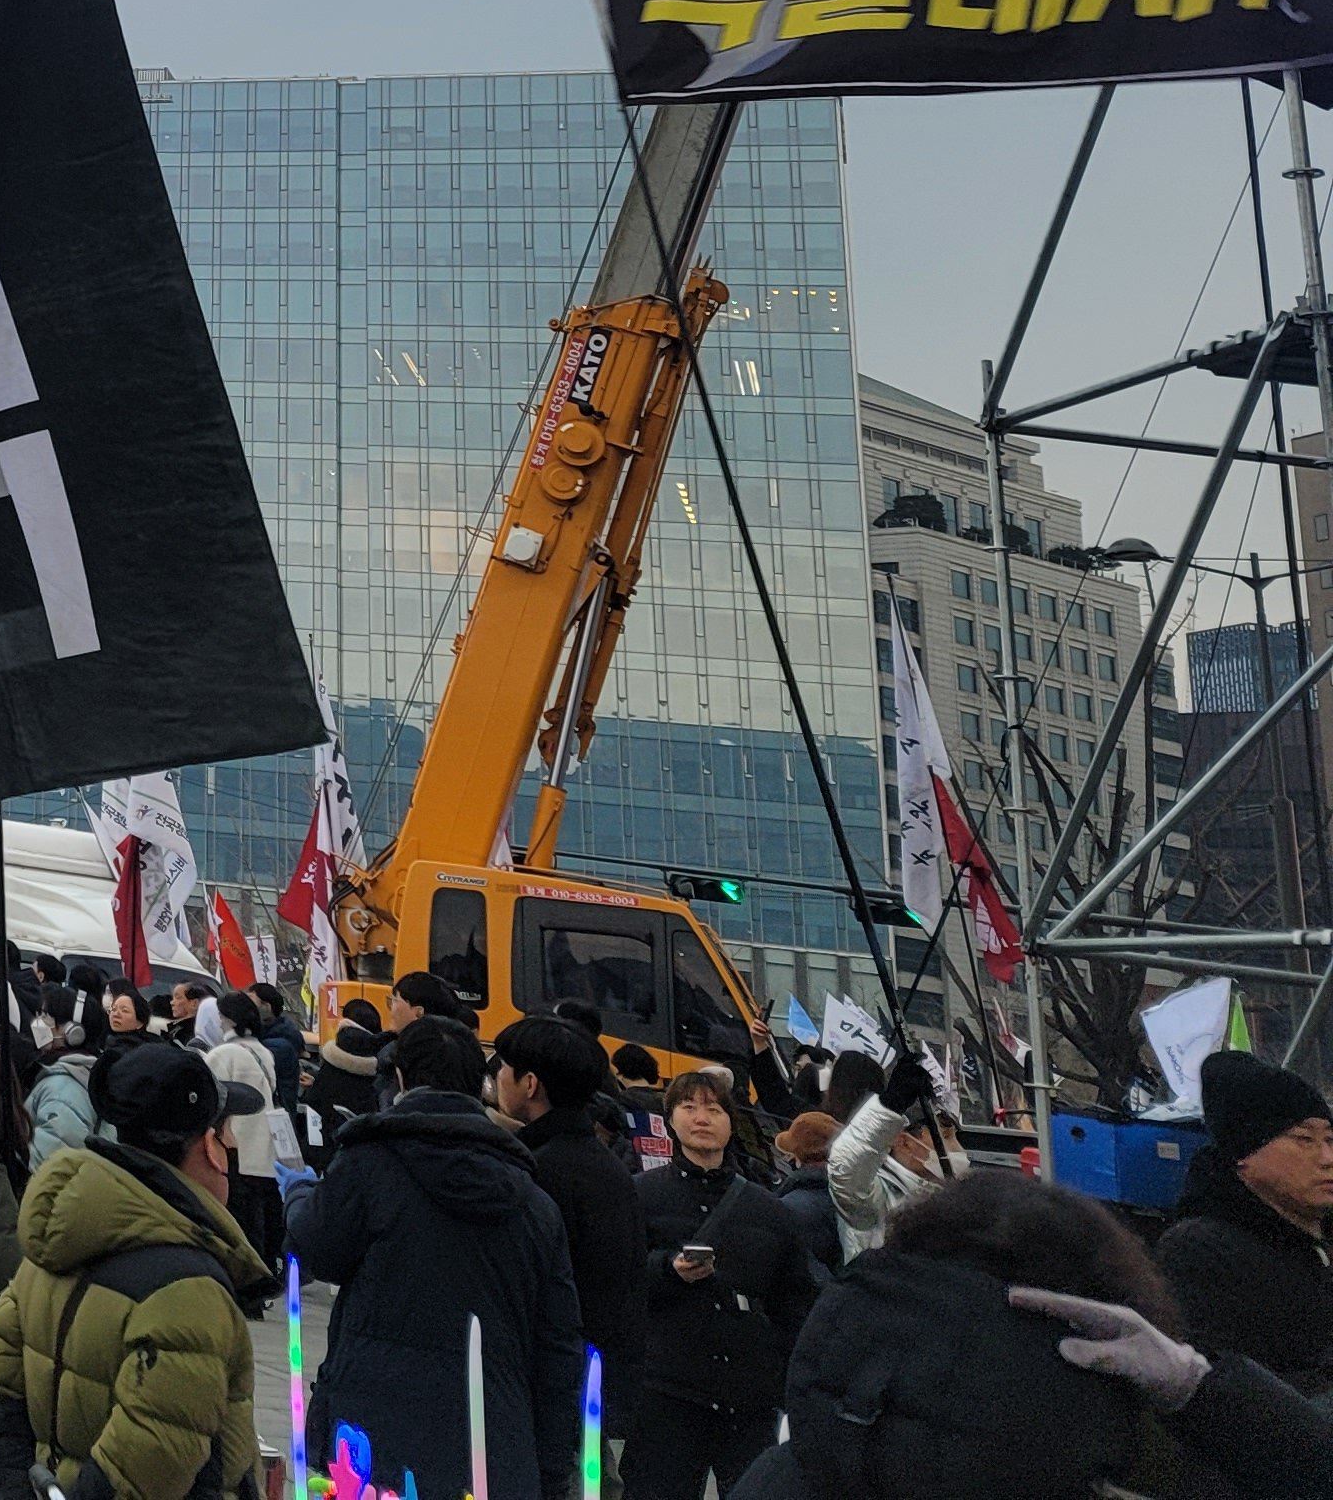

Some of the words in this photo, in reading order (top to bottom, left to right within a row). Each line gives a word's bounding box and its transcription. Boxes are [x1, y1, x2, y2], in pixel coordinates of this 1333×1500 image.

[540, 341, 584, 441] 010-6333-4004
[572, 333, 608, 401] KATO
[550, 888, 639, 906] 010-6333-4004
